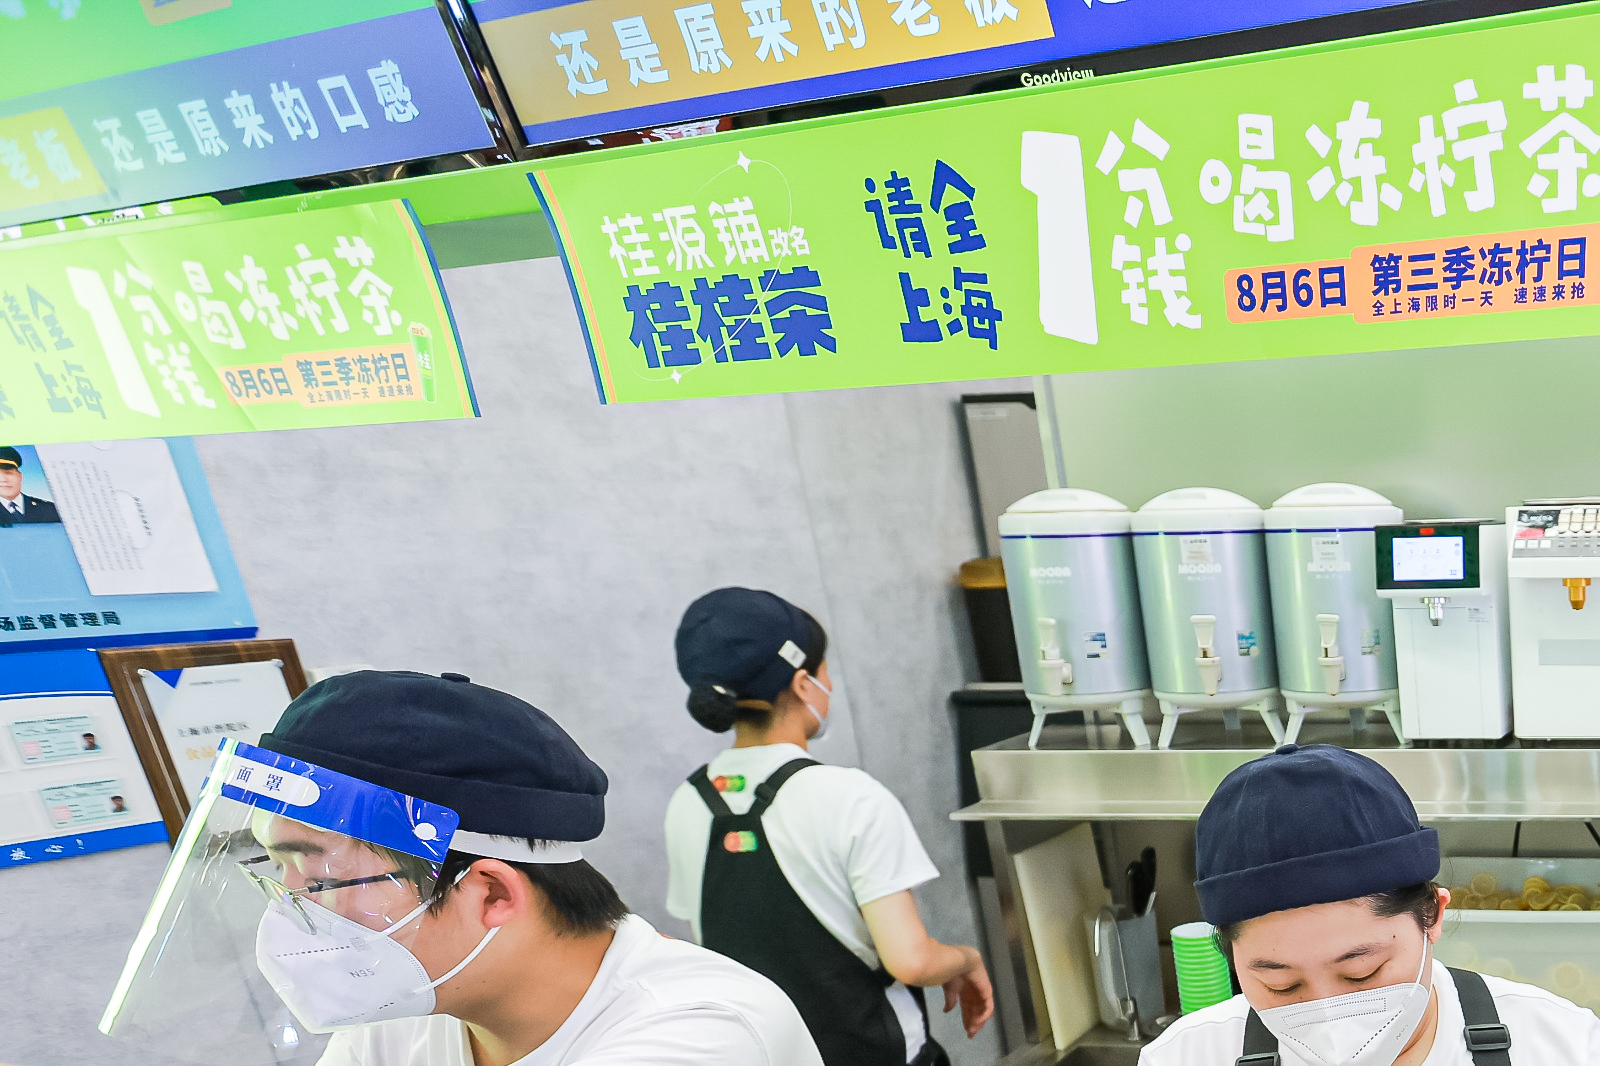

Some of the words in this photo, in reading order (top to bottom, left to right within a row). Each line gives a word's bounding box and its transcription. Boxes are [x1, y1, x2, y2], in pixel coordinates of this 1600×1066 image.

[1021, 69, 1094, 87] Goodview
[93, 58, 419, 174] 还是原来的口感
[864, 158, 987, 259] 请全
[600, 195, 769, 279] 桂源铺
[768, 225, 811, 258] 改名
[1236, 265, 1348, 315] 8月6日
[1370, 235, 1588, 298] 第三季冻柠日
[899, 266, 1003, 350] 上海
[1371, 290, 1495, 319] 全上海限时一天
[1513, 282, 1586, 306] 速速来抢
[34, 359, 107, 420] 上海
[224, 367, 293, 399] 8月6日
[296, 352, 411, 389] 第三季冻柠日
[237, 765, 283, 792] 面罩
